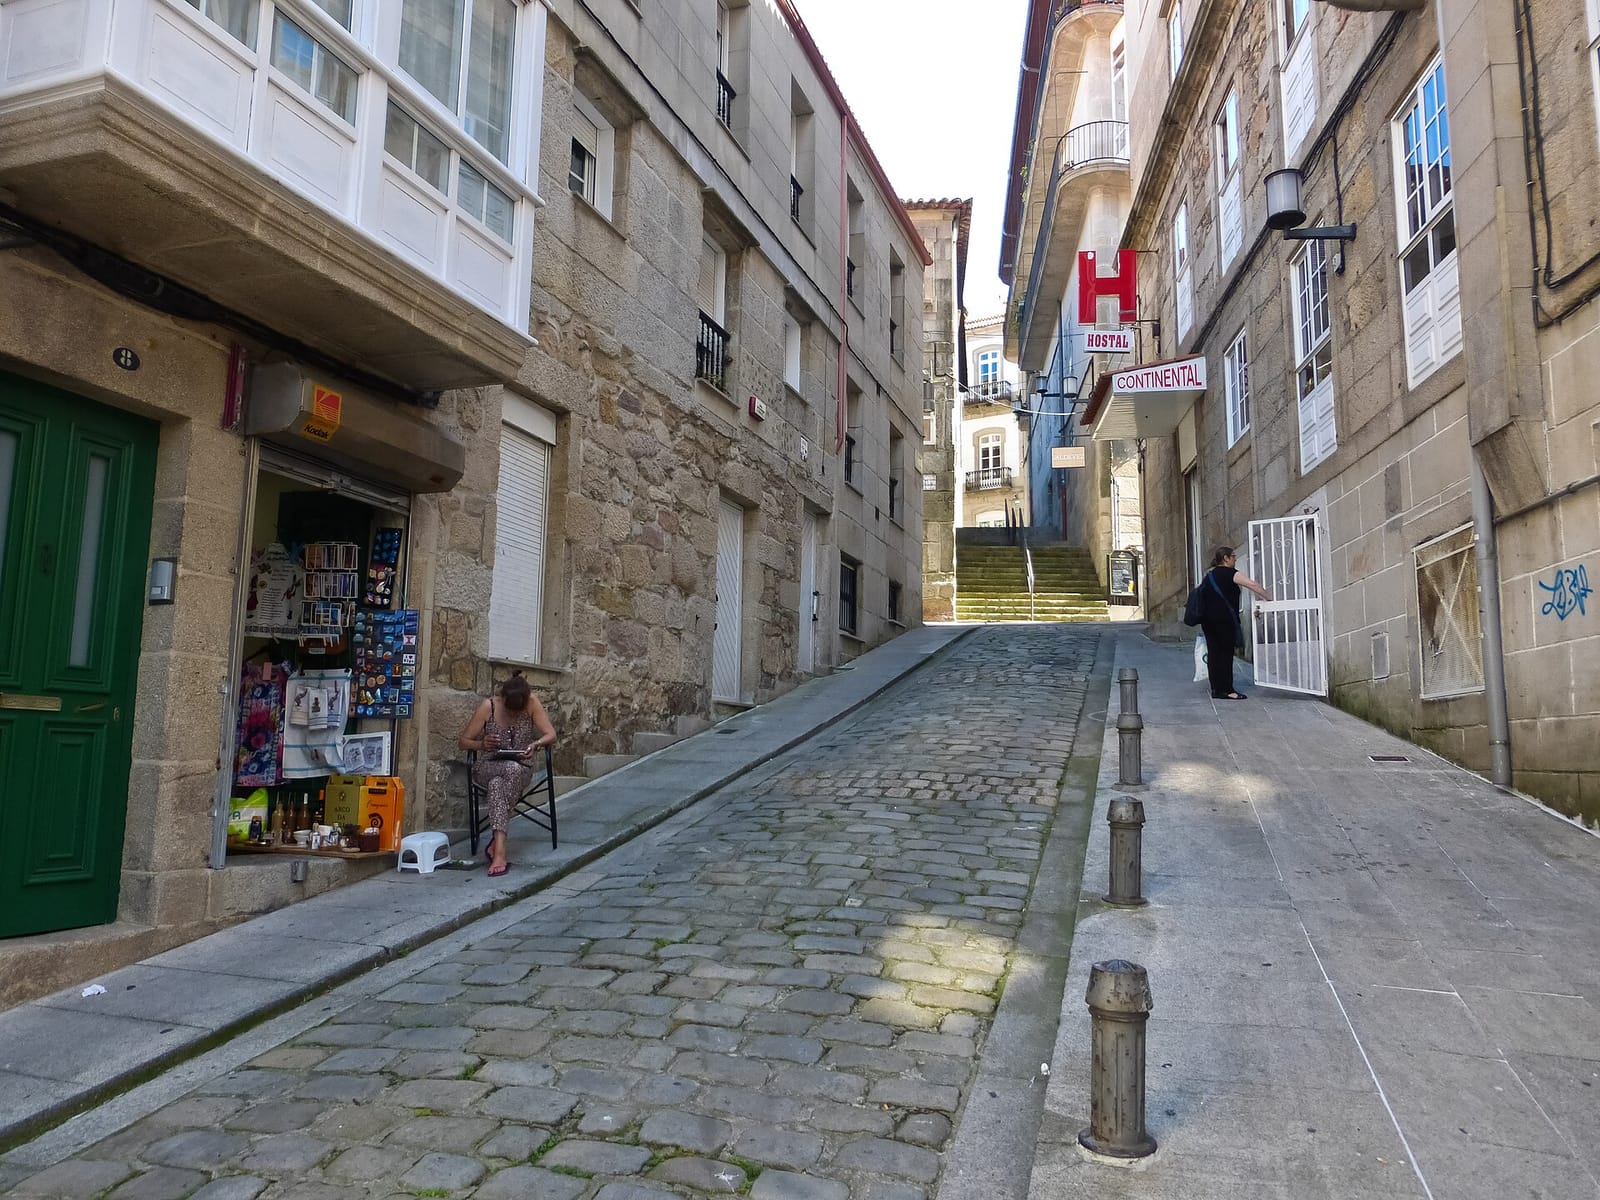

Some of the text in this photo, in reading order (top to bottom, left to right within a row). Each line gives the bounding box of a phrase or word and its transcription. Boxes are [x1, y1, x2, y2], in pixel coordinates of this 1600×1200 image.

[1078, 249, 1137, 325] H
[1087, 333, 1129, 349] HOSTAL
[120, 349, 132, 367] 8
[1117, 363, 1202, 389] CONTINENTAL
[304, 423, 329, 439] Kodak
